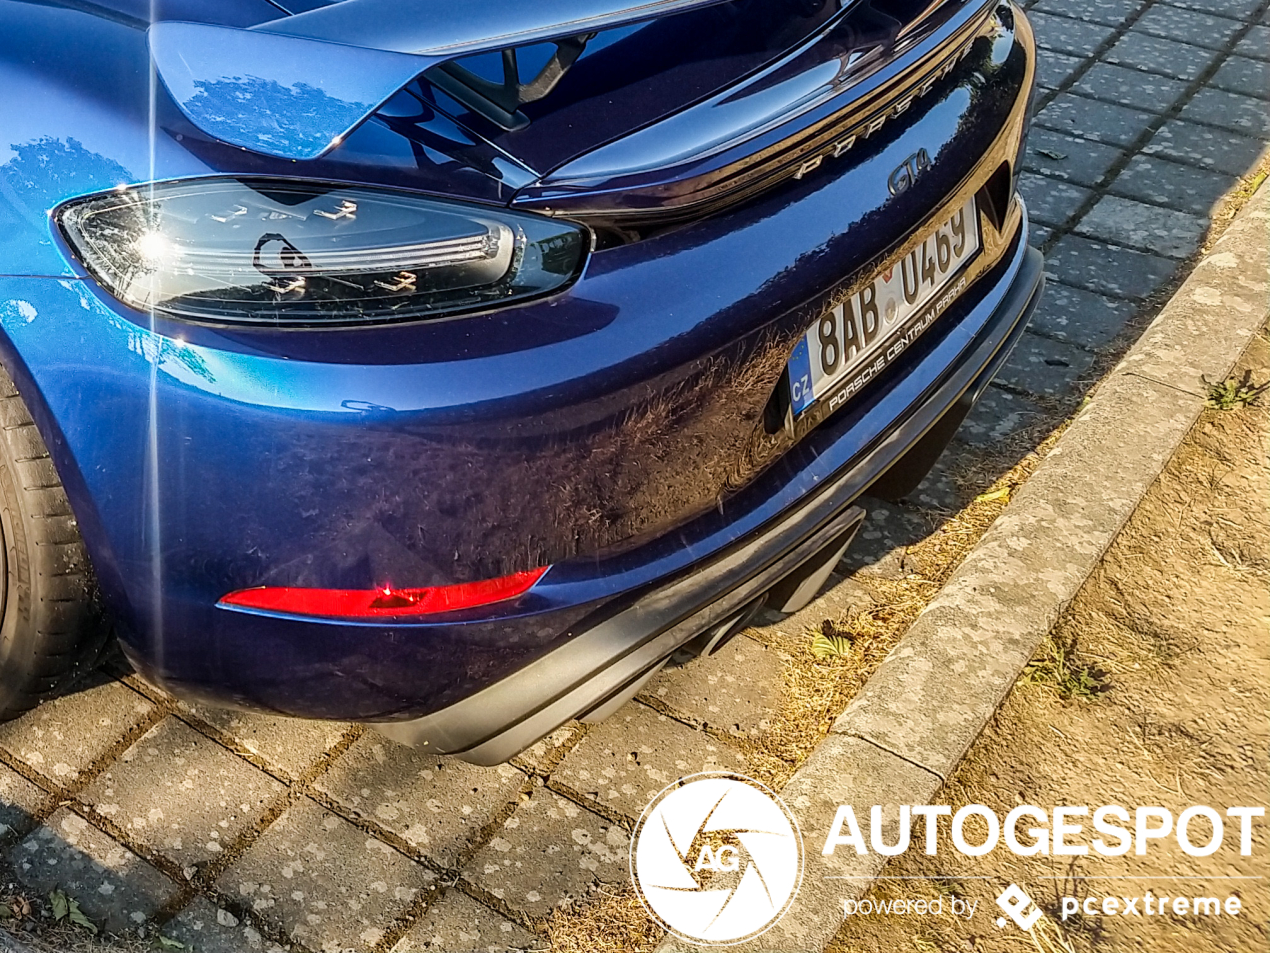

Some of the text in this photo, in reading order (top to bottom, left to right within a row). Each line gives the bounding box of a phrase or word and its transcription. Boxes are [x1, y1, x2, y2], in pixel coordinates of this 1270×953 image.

[792, 37, 975, 180] PORSCHE
[888, 147, 931, 196] GT4
[792, 206, 966, 402] CZ 8AB 0469
[829, 276, 967, 411] PORSCHE CENTRUM PRAHA
